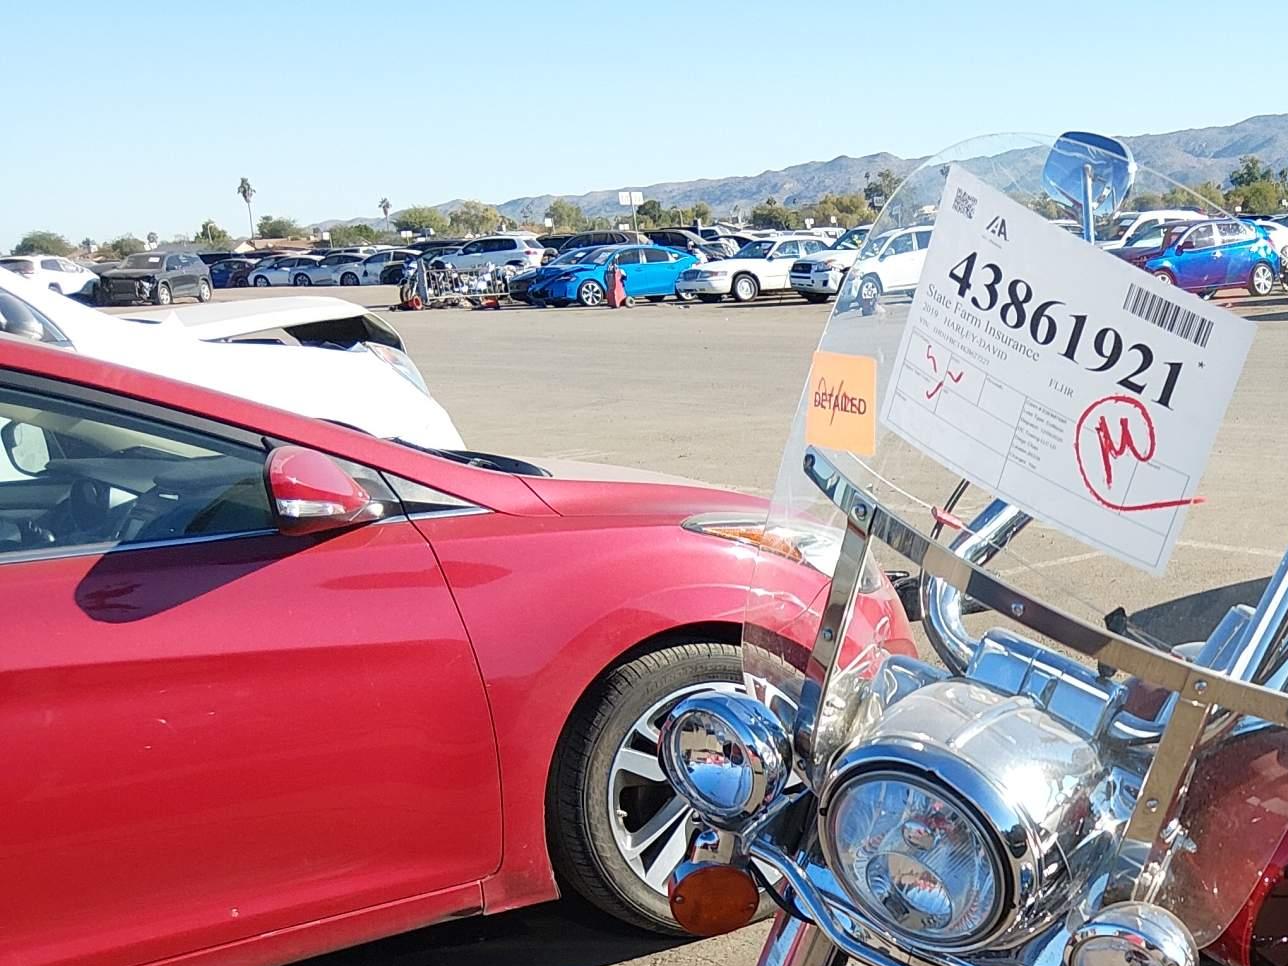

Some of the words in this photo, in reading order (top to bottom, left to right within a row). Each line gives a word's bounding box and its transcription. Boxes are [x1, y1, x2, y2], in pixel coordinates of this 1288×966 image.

[926, 283, 952, 309] State
[953, 300, 981, 330] Farm
[984, 320, 1041, 362] Insurance
[948, 251, 1184, 411] 43861921
[813, 391, 867, 415] DETAILED
